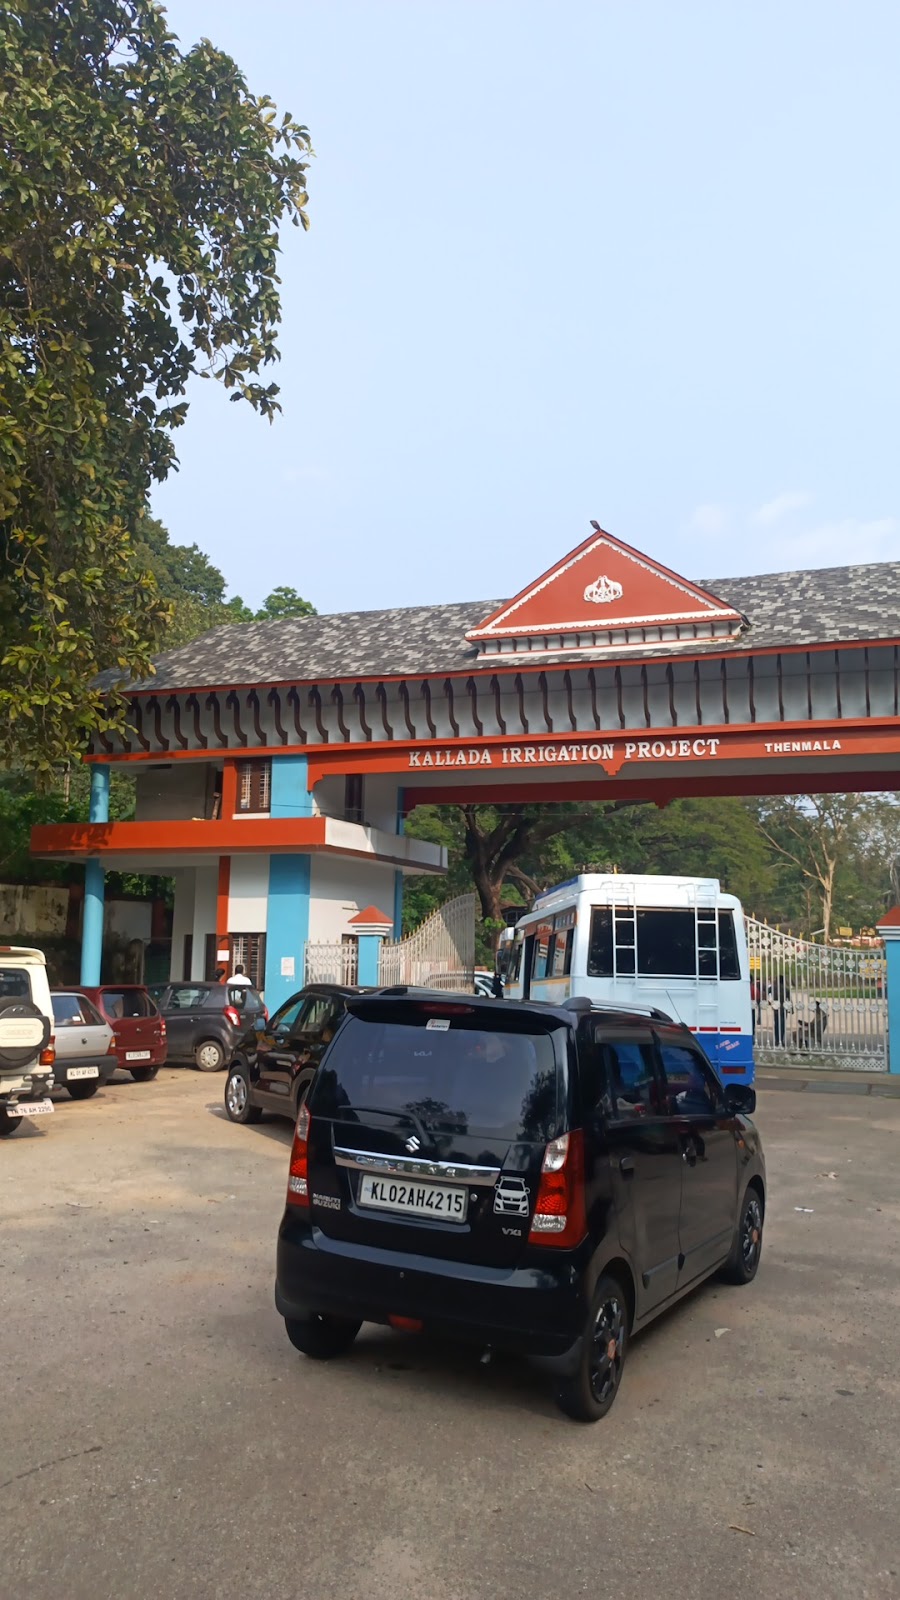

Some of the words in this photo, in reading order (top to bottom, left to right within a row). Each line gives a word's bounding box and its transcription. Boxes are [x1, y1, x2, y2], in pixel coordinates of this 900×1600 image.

[408, 749, 492, 767] KALLADA
[501, 743, 615, 764] IRRIGATION
[624, 738, 720, 759] PROJECT
[764, 739, 842, 753] THENMALA
[312, 1192, 341, 1204] MARUTI
[371, 1181, 463, 1213] KL02AH4215
[312, 1198, 341, 1211] SUZUKI
